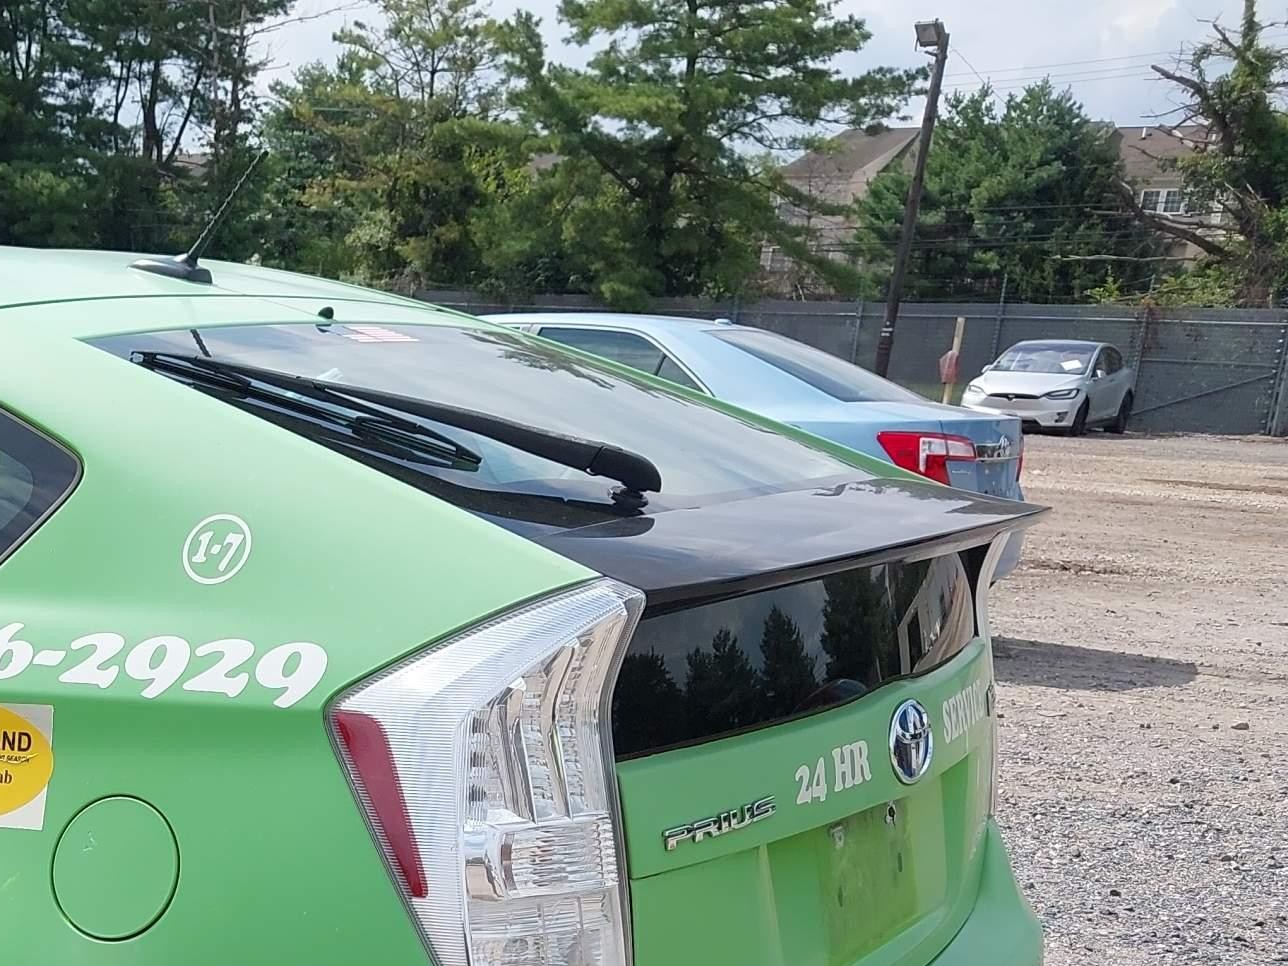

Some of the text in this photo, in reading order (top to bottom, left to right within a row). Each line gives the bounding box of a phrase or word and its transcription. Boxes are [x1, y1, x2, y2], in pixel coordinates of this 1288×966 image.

[794, 756, 828, 805] 24
[832, 740, 872, 793] HR
[661, 794, 777, 852] PRIUS
